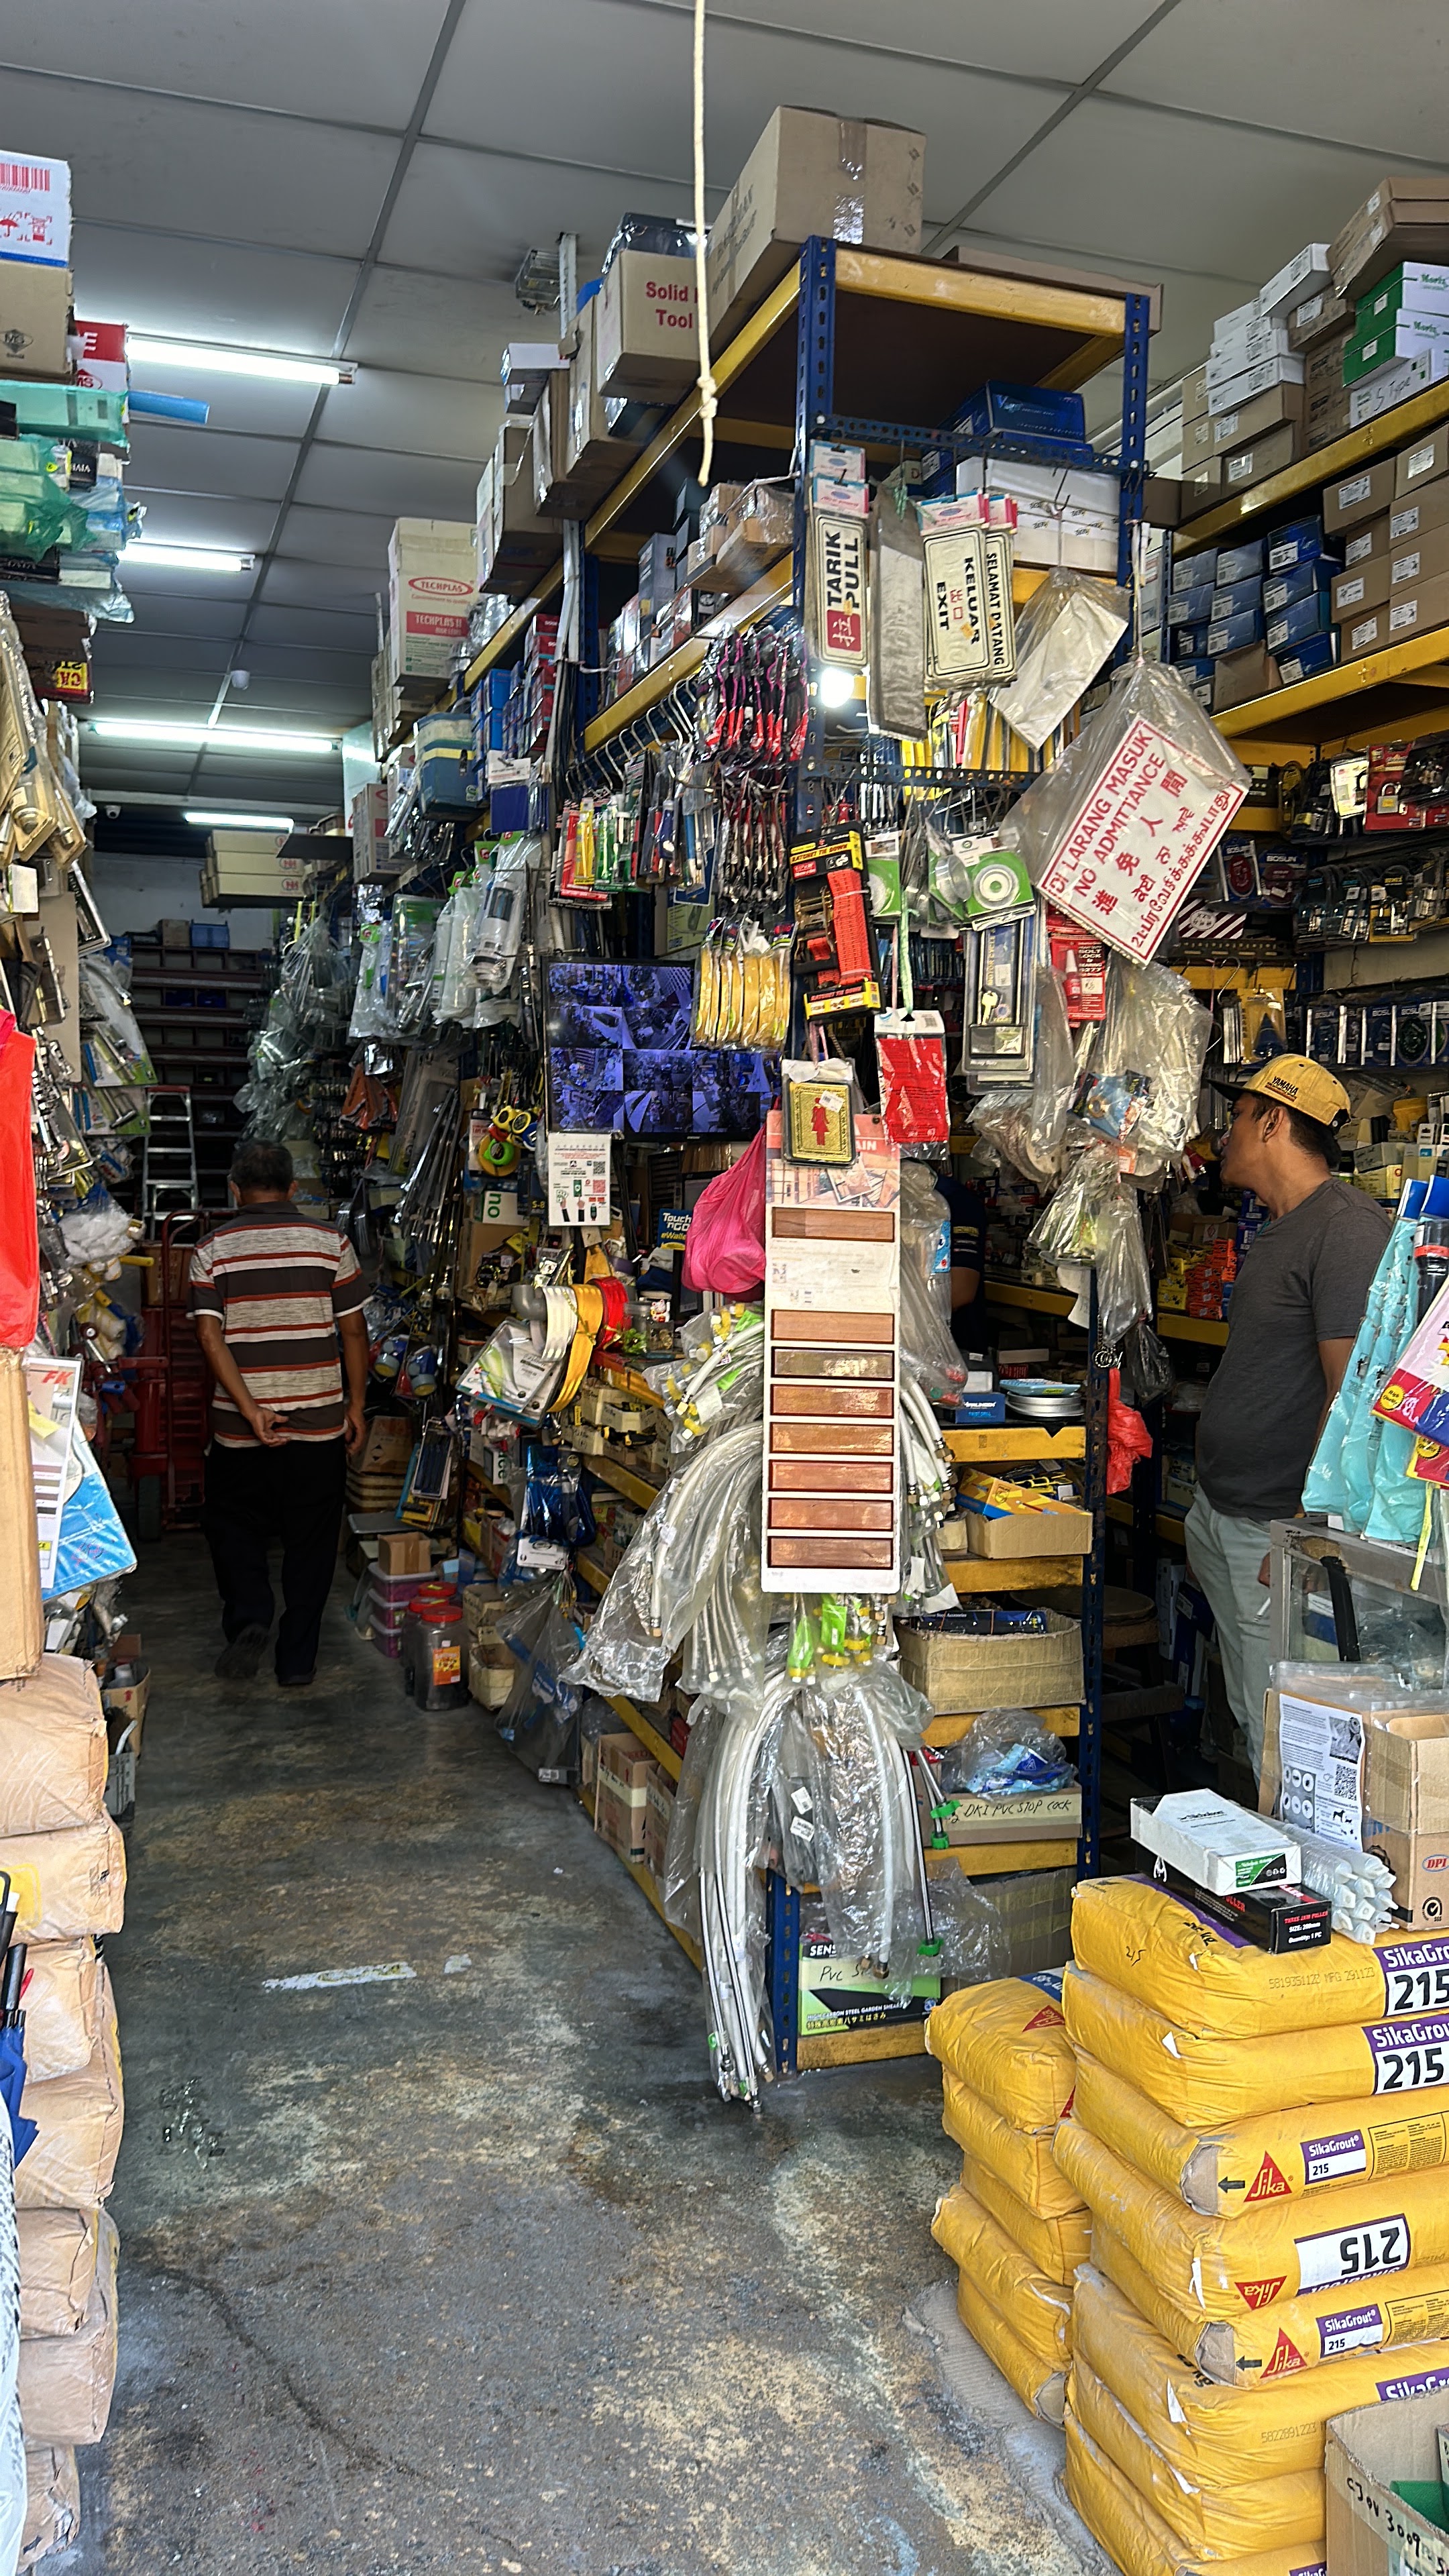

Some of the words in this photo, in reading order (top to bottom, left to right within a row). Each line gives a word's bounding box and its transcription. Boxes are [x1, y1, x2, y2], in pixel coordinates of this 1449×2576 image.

[646, 281, 688, 303] Solid
[655, 309, 693, 329] Tool
[825, 530, 842, 607] TARIK
[844, 537, 860, 608] PULL
[986, 553, 1001, 605] SELAMAT
[420, 580, 464, 593] TECHPLAS
[936, 581, 950, 631] EXIT
[949, 588, 963, 621] 出口
[964, 556, 980, 645] KELUAR
[415, 614, 454, 628] TECHPLAS
[832, 616, 856, 647] 拉
[990, 611, 1006, 665] DATANG
[1049, 872, 1069, 895] DI
[1061, 798, 1113, 871] LARANG
[1105, 729, 1154, 796] MASUK
[1073, 866, 1098, 898] NO
[1091, 752, 1166, 865] ADMITTANCE
[1267, 855, 1297, 863] BOSUN
[1272, 1075, 1299, 1095] YAMAHA
[663, 1212, 692, 1224] Touch
[41, 1370, 74, 1385] FK
[1383, 1395, 1399, 1405] Quality
[1388, 1389, 1400, 1399] High
[992, 1803, 1014, 1817] PVC
[1017, 1799, 1042, 1814] STOP
[1426, 1858, 1448, 1869] DPI
[1311, 1911, 1328, 1919] PULLER
[1288, 1934, 1311, 1943] Quantity:
[1289, 1925, 1302, 1933] SIZE:
[1393, 1968, 1449, 2011] 215
[861, 2005, 883, 2013] GARDEN
[1372, 2022, 1449, 2049] SikaGrou
[1383, 2047, 1445, 2092] 215
[1312, 2163, 1330, 2176] 215
[1250, 2167, 1285, 2200] Sika
[1340, 2226, 1401, 2276] 215
[1244, 2282, 1282, 2308] Sika
[1328, 2338, 1346, 2351] 215
[1267, 2345, 1301, 2375] Sika
